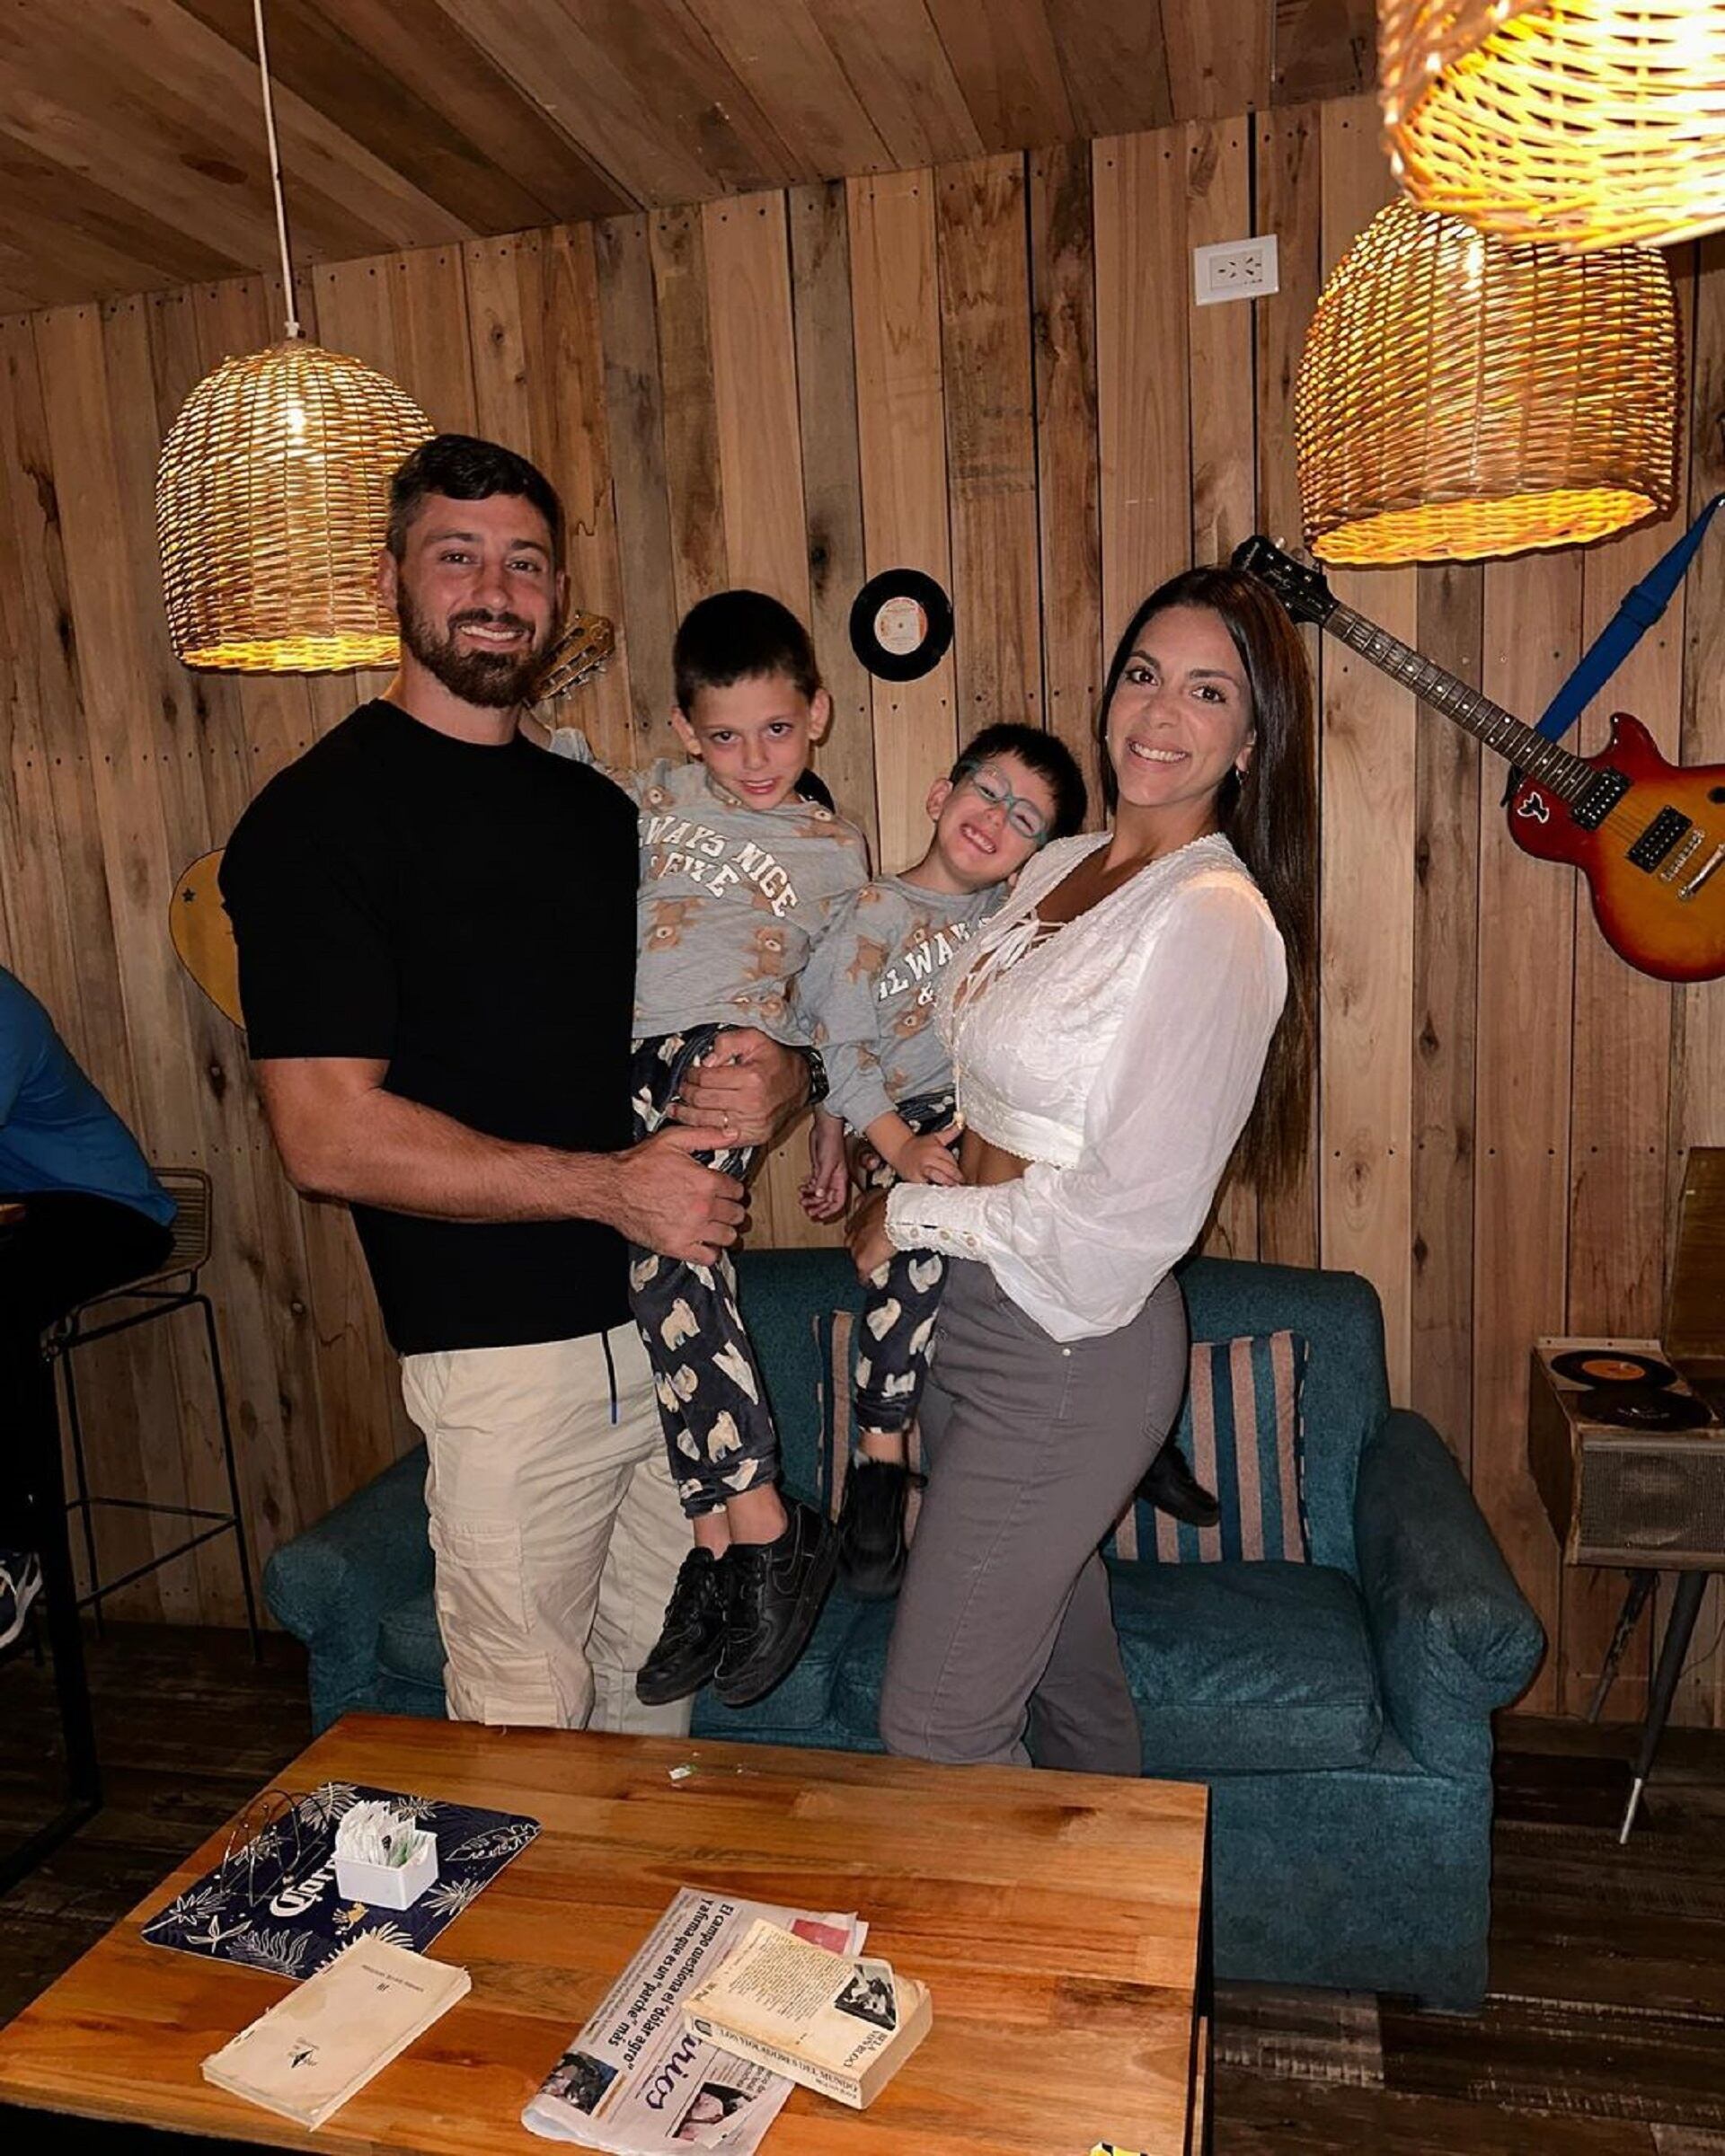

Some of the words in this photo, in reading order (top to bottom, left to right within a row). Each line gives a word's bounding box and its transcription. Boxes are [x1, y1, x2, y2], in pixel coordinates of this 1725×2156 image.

[637, 816, 730, 857] WAYS
[730, 841, 799, 917] NICE
[270, 1857, 337, 1917] Cor
[683, 1904, 709, 1937] afirma
[719, 1904, 733, 1915] El
[699, 1914, 723, 1947] campo
[670, 1936, 688, 1955] que
[652, 1965, 668, 1980] un
[662, 1954, 676, 1966] es
[668, 1946, 703, 1993] cuestiona
[660, 1992, 674, 2005] el
[607, 2021, 630, 2046] más
